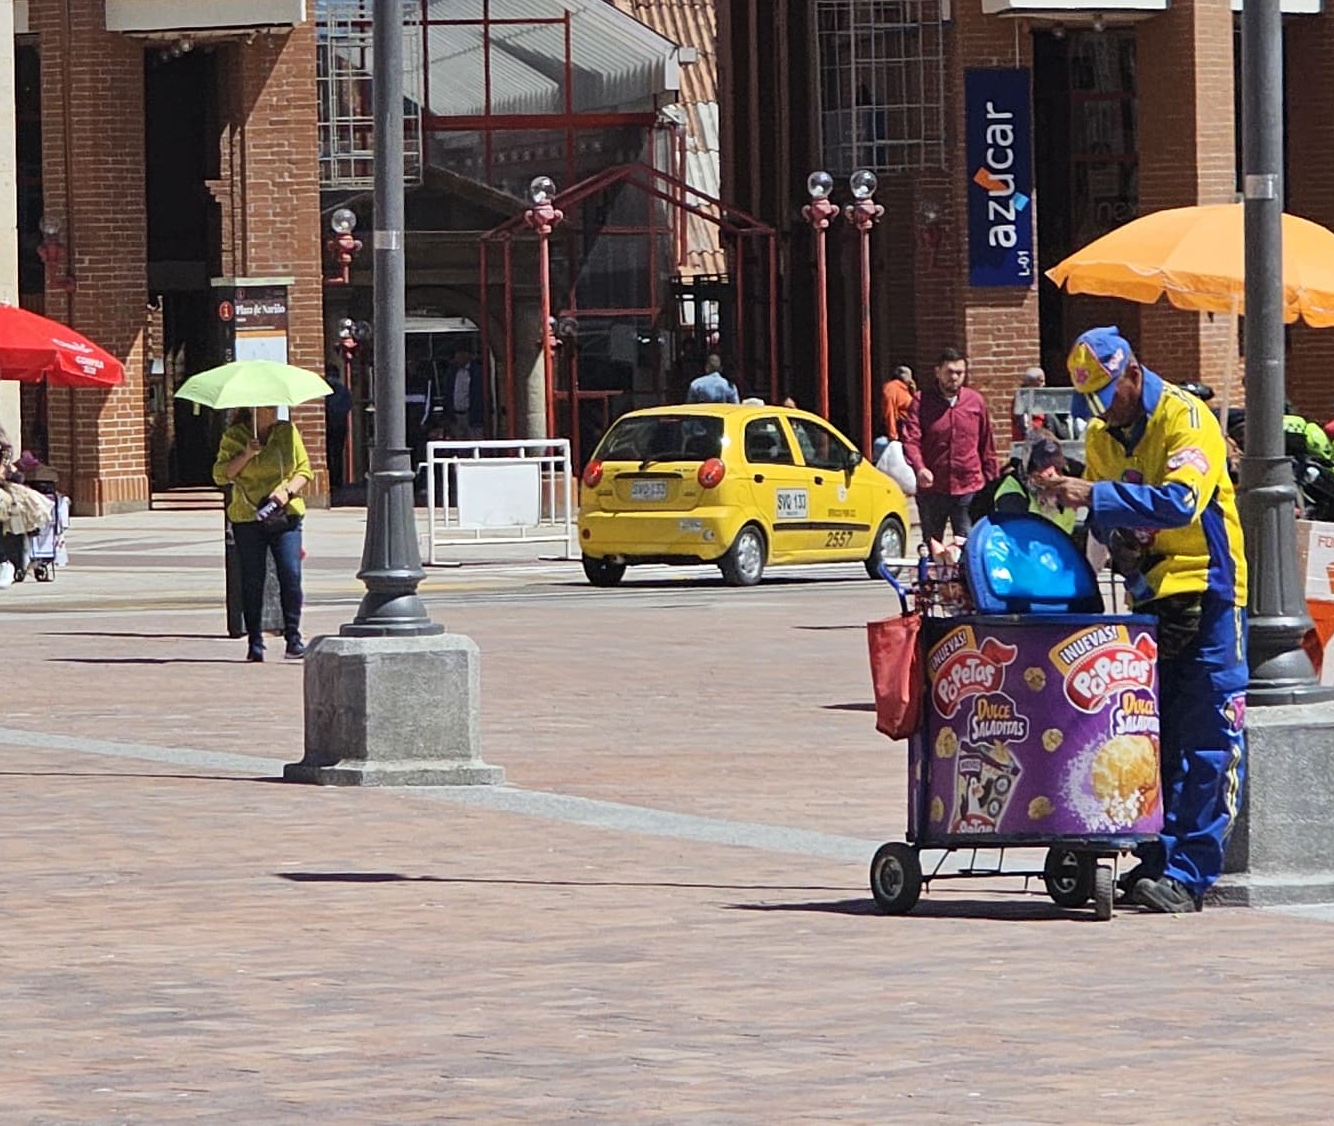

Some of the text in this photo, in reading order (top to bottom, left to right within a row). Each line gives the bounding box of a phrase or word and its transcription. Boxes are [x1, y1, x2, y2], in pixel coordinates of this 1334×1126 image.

[1016, 250, 1031, 277] L-01
[825, 531, 854, 548] 2557
[971, 716, 1025, 740] SALADITAS
